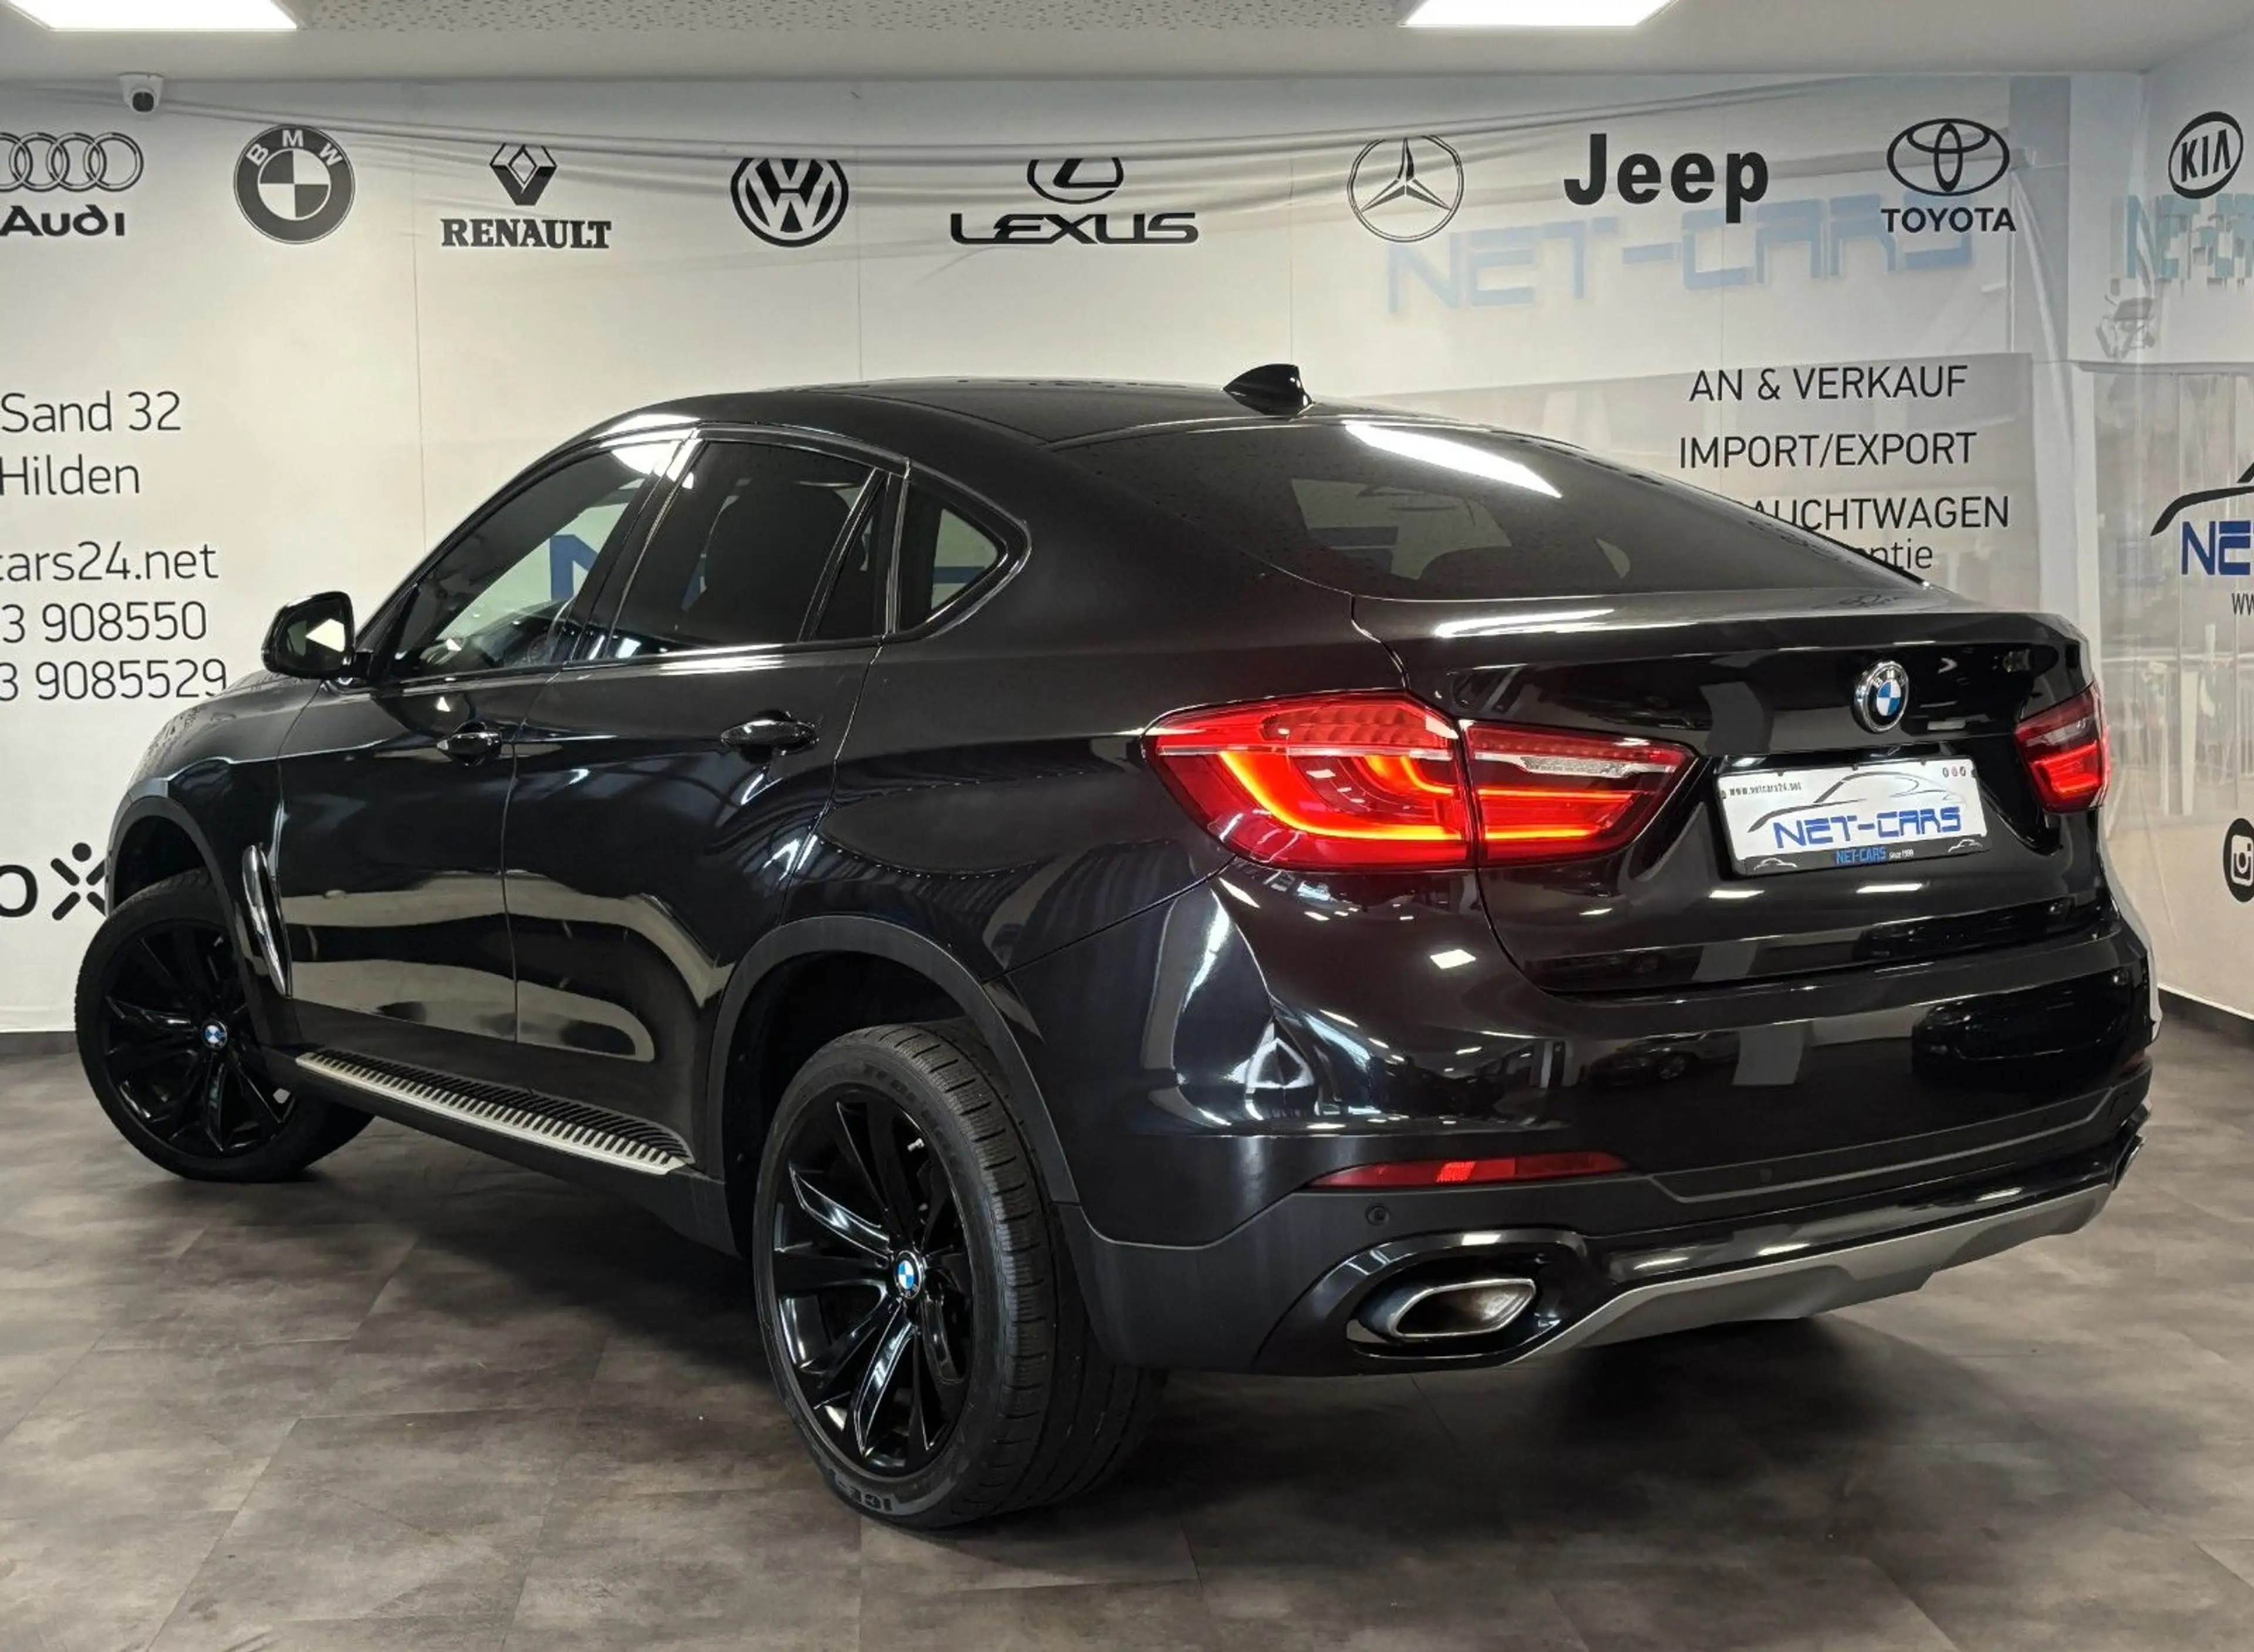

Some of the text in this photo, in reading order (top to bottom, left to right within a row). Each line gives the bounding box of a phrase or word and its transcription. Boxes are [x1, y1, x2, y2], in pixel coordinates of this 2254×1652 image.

[245, 128, 344, 167] BMW
[2180, 129, 2232, 183] KIA
[1564, 133, 1769, 224] Jeep
[440, 218, 612, 249] RENAULT
[950, 212, 1199, 244] LEXUS
[1881, 207, 2017, 233] TOYOTA
[1689, 365, 1968, 401] AN & VERKAUF
[1, 391, 181, 432] Sand 32
[1679, 431, 1978, 469] IMPORT/EXPORT
[0, 454, 140, 495] Hilden
[0, 541, 219, 581] ars24.net
[2181, 520, 2254, 576] NE
[2, 602, 207, 643] 3 908550
[0, 658, 227, 701] 3 9085529
[1773, 806, 1961, 849] NET-CARS
